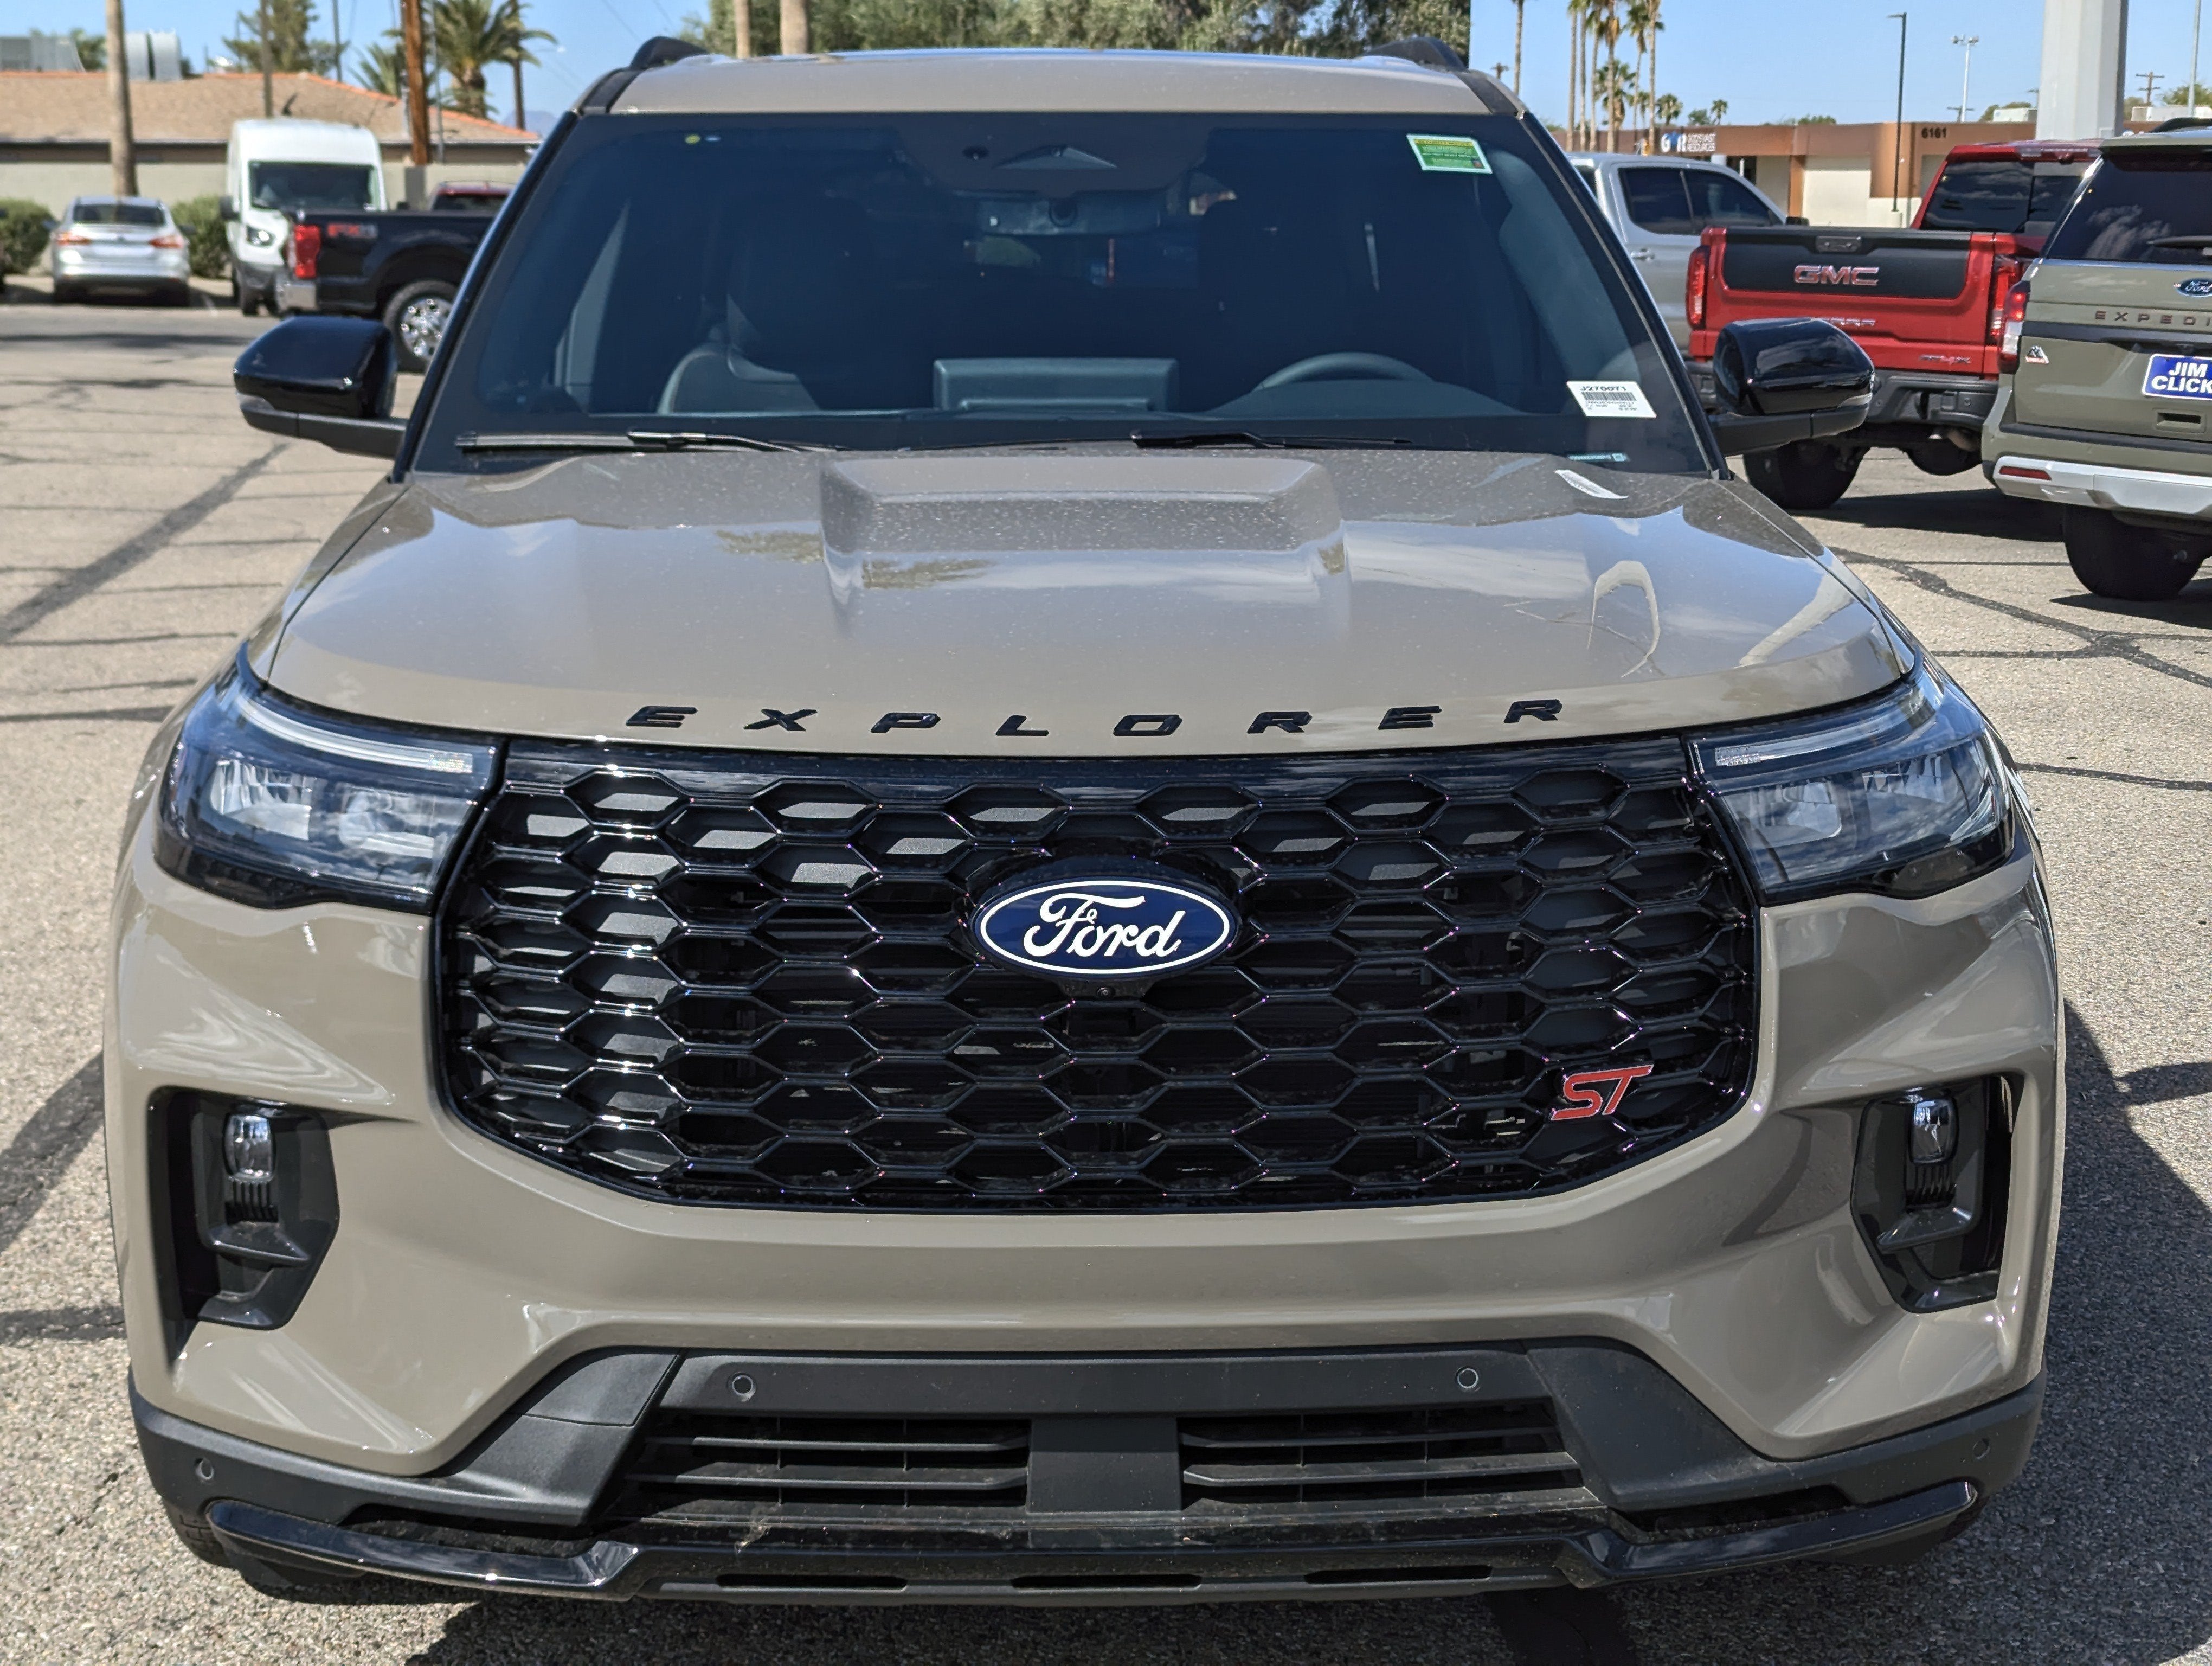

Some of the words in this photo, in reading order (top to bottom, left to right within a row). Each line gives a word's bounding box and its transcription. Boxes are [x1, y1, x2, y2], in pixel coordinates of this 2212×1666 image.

[1921, 127, 1946, 139] 6161
[1794, 265, 1879, 286] GMC
[2169, 362, 2209, 377] JIM
[2151, 375, 2212, 394] CLICK
[626, 699, 1564, 736] EXPLORER
[1024, 893, 1186, 957] Ford
[1551, 1063, 1654, 1121] ST
